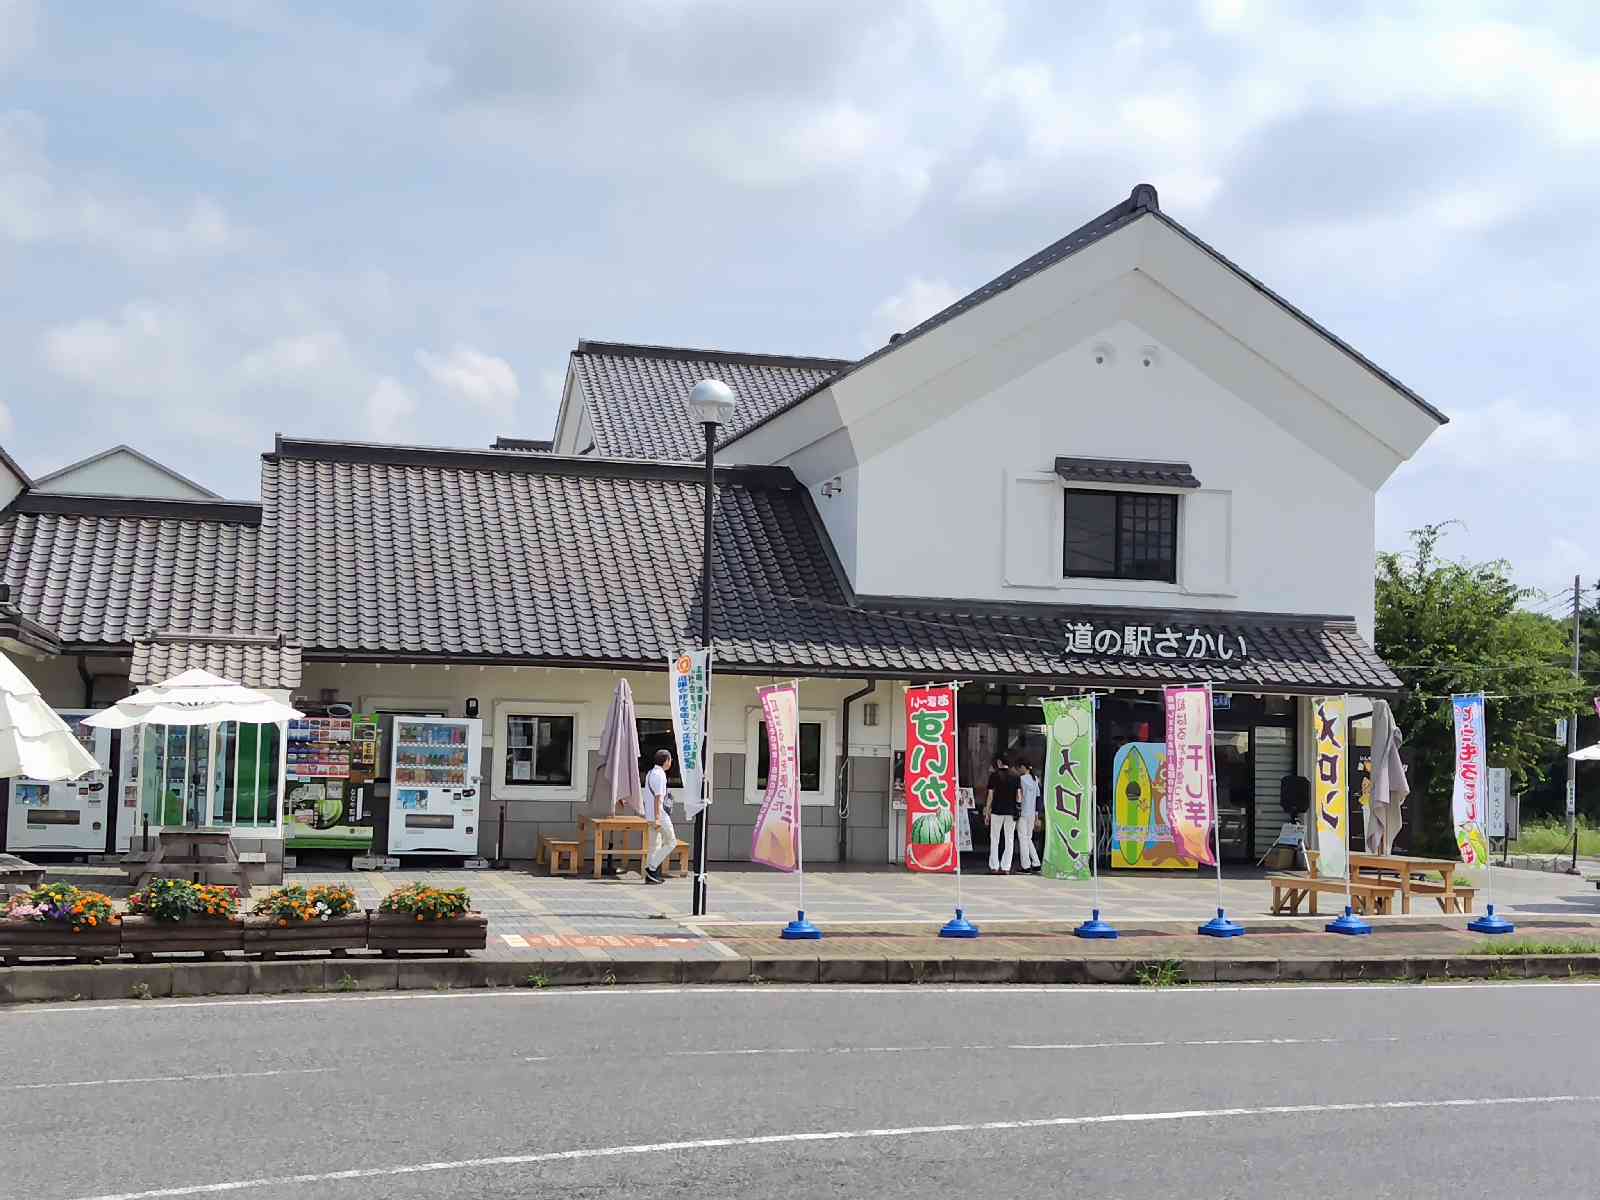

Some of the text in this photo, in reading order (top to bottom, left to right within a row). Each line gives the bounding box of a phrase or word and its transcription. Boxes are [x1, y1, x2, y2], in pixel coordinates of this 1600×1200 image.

[1065, 622, 1248, 660] 道の駅さかい
